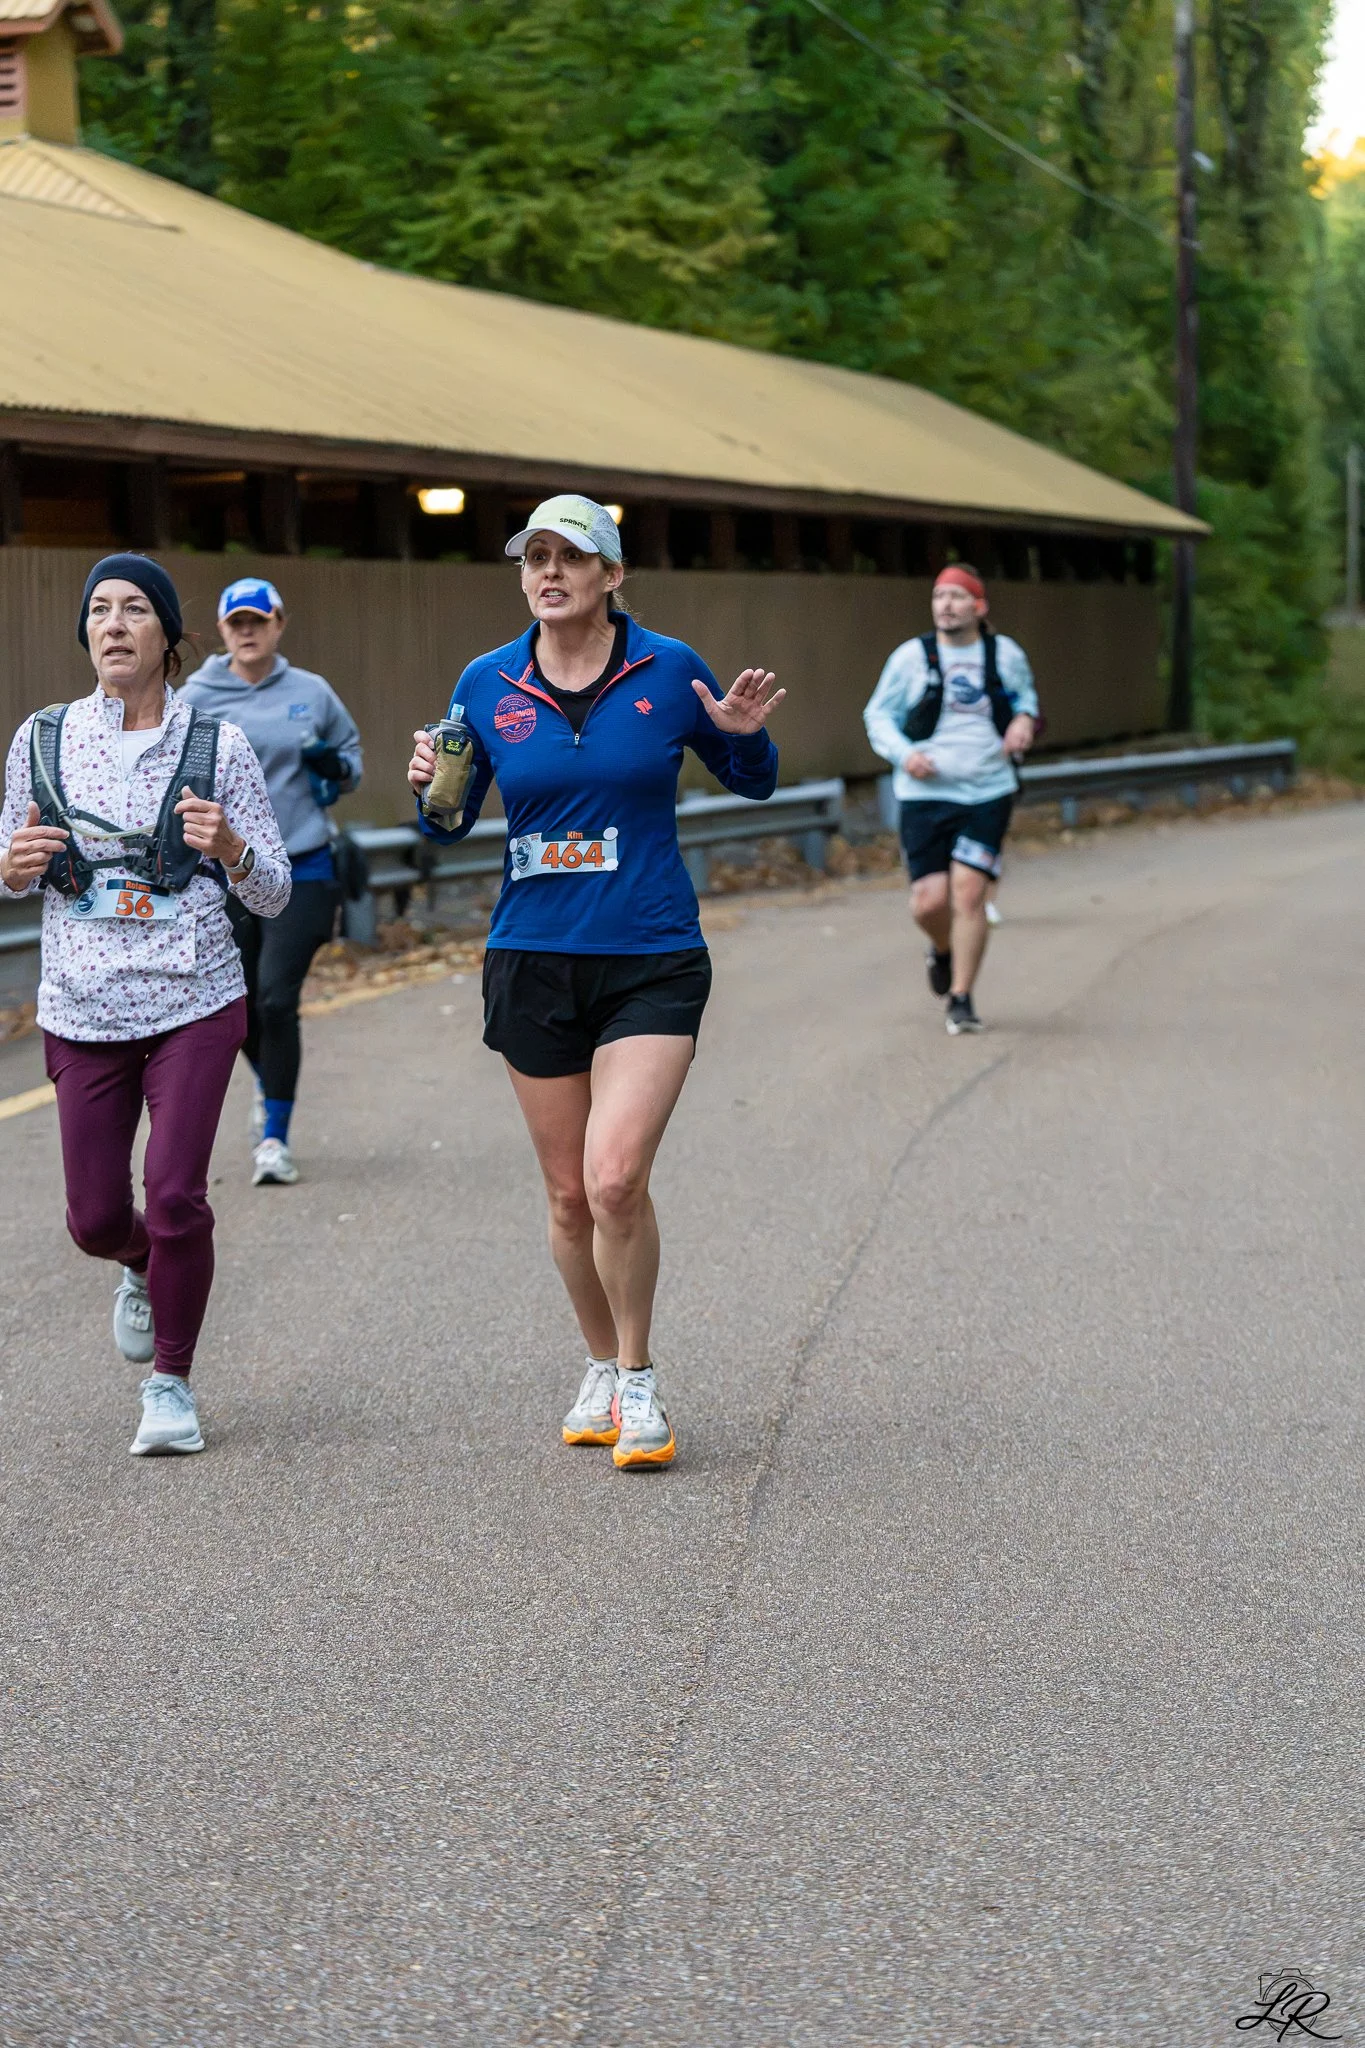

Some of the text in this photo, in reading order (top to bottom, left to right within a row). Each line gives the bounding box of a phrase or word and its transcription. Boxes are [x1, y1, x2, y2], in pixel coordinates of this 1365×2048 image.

[560, 518, 587, 531] SPRINTS
[567, 831, 584, 840] Kim
[541, 842, 605, 869] 464
[115, 891, 154, 918] 56
